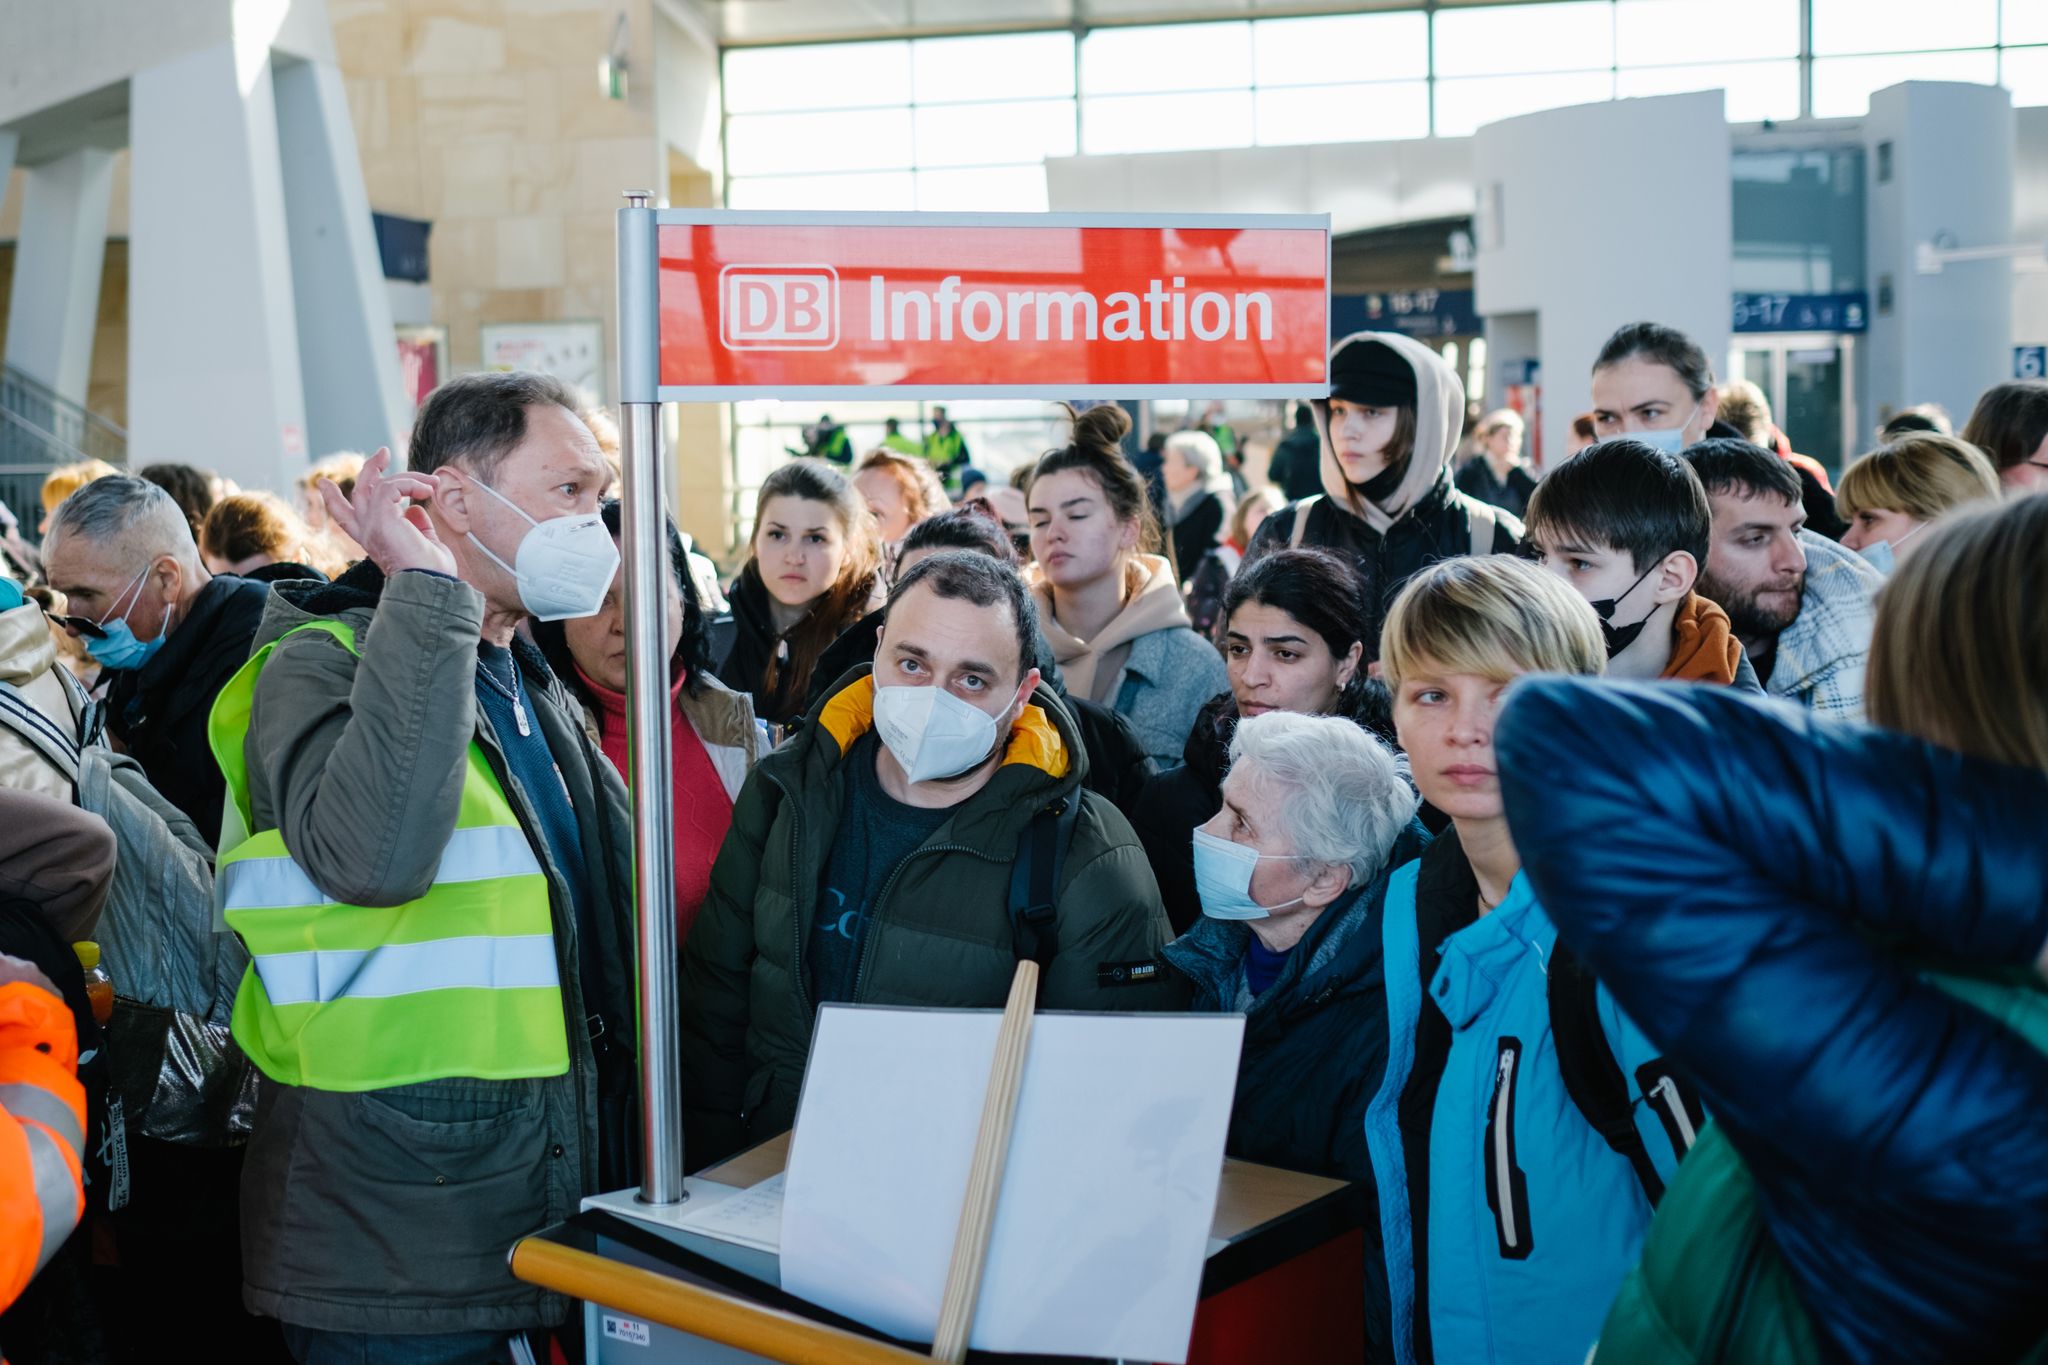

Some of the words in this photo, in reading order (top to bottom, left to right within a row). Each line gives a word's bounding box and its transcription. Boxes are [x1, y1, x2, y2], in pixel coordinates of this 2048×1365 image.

[738, 281, 824, 335] DB
[870, 275, 1273, 342] Information
[2019, 348, 2041, 379] 6
